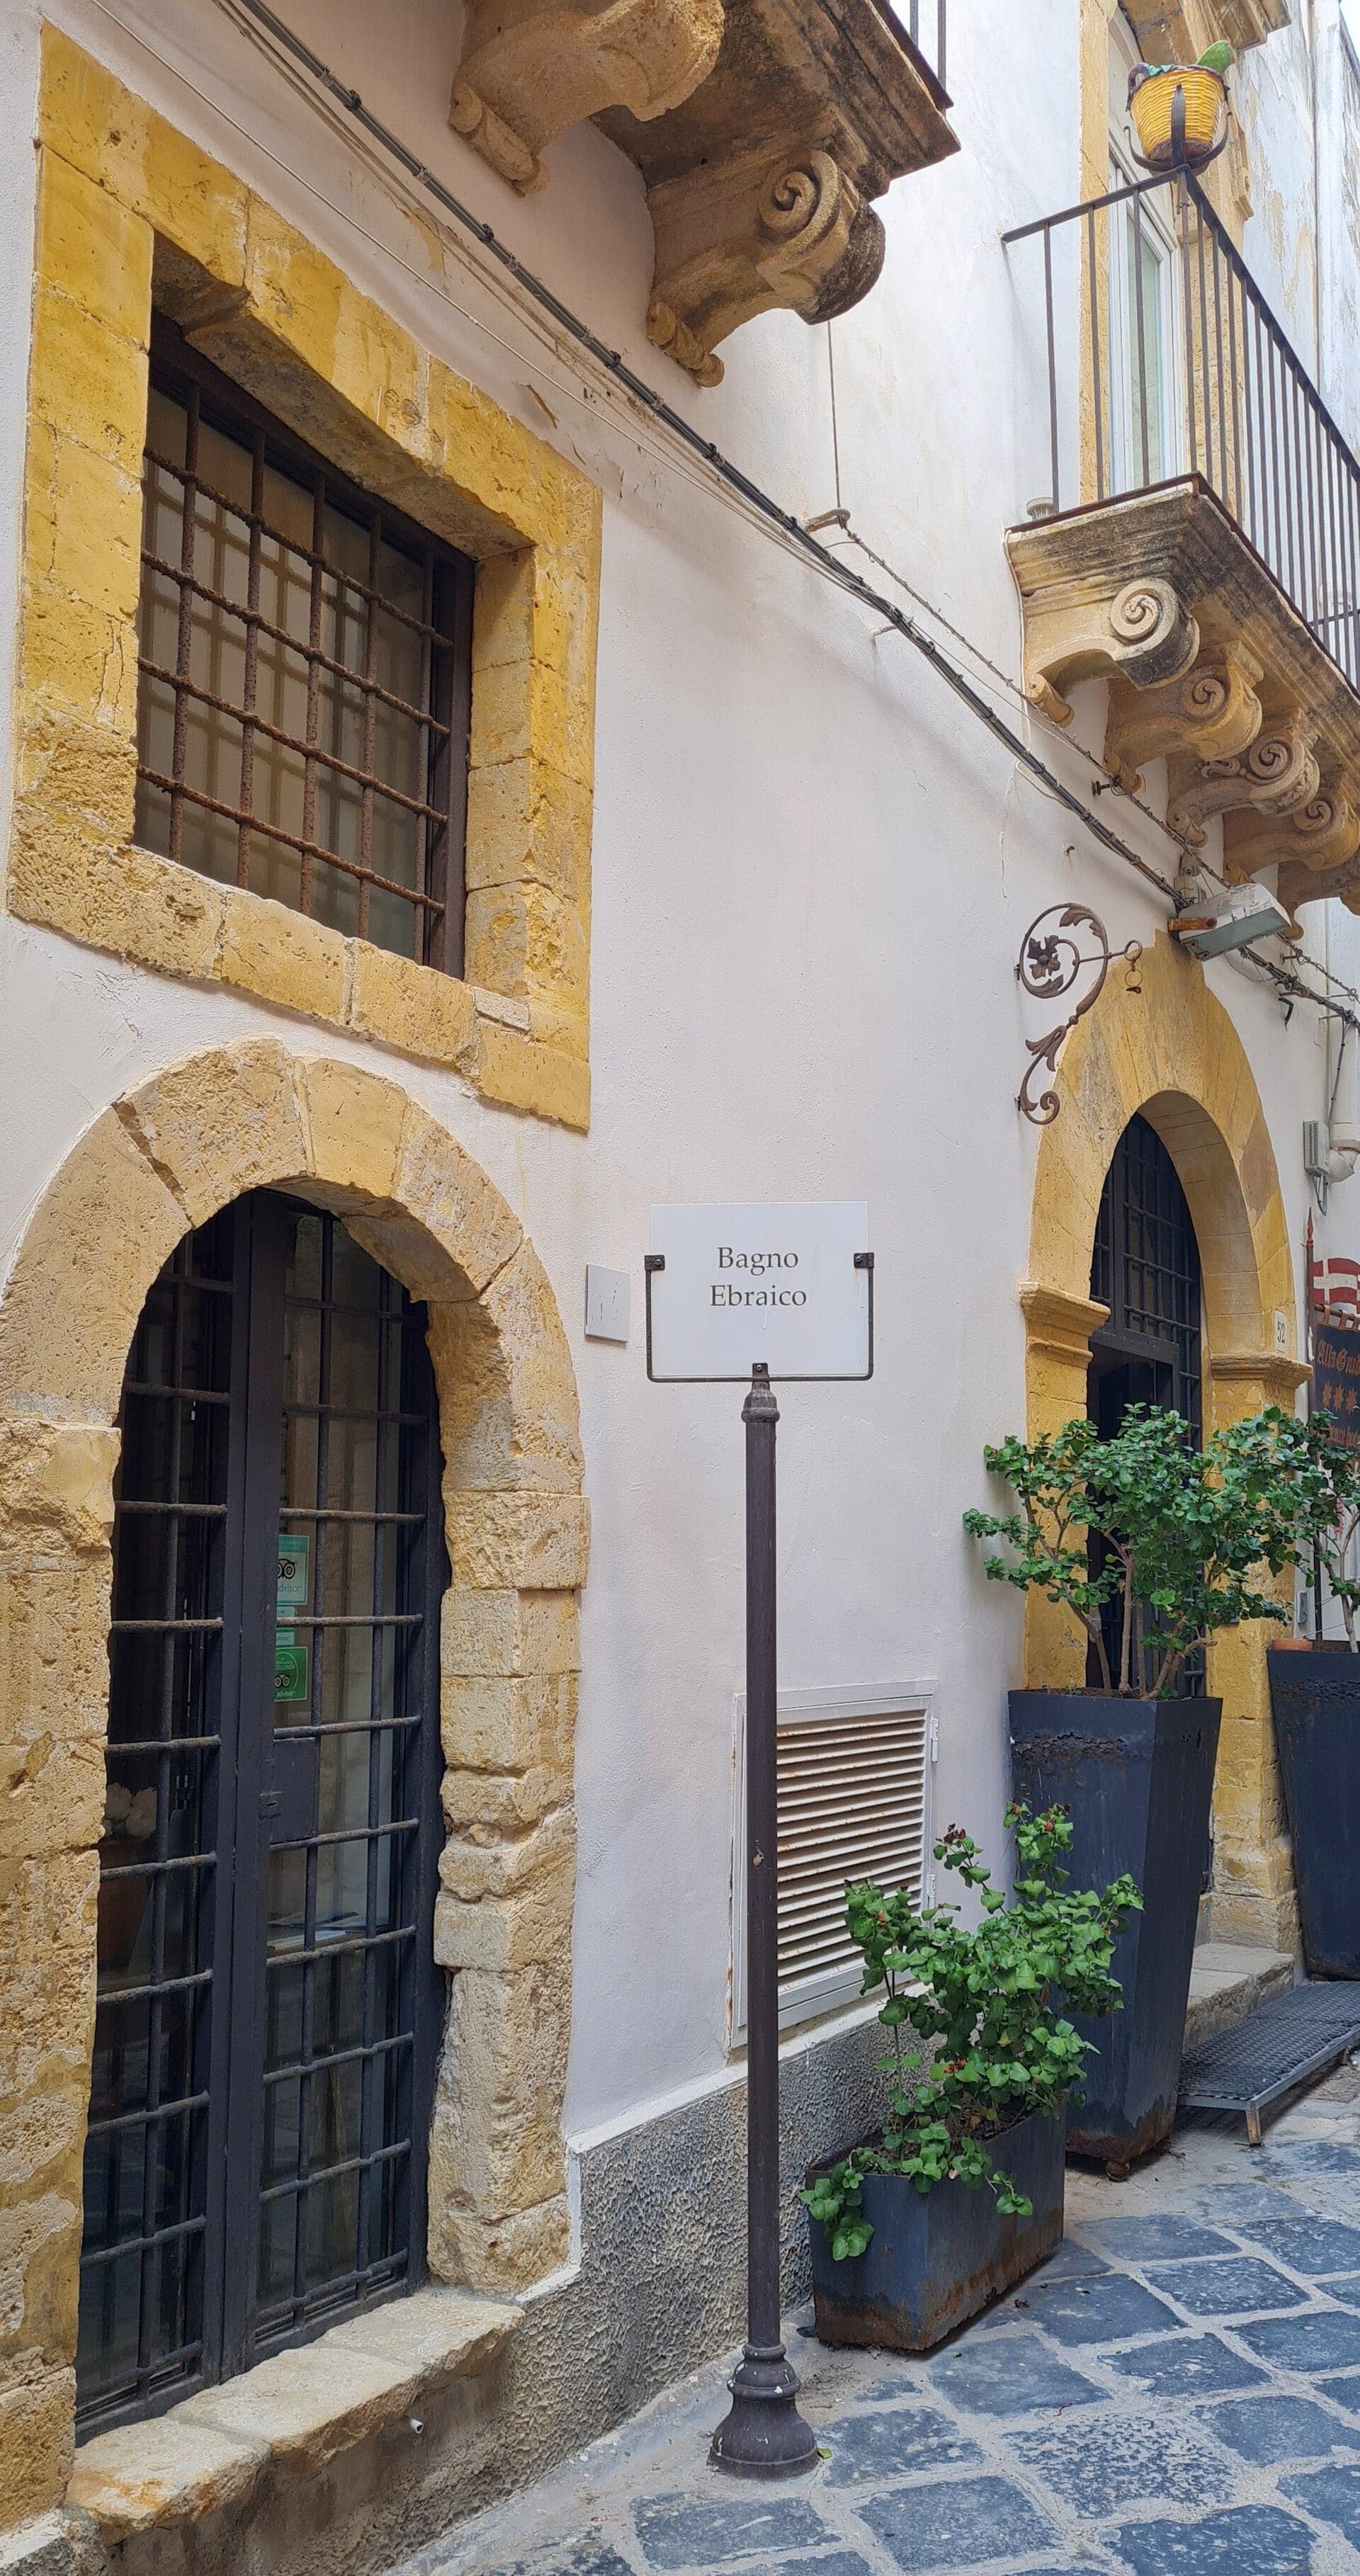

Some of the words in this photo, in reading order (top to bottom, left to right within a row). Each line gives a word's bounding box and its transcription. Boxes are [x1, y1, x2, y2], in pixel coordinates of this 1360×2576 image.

[717, 1247, 799, 1276] Bagno
[709, 1284, 808, 1307] Ebraico
[1277, 1320, 1286, 1344] 52
[278, 1583, 302, 1593] dvisor
